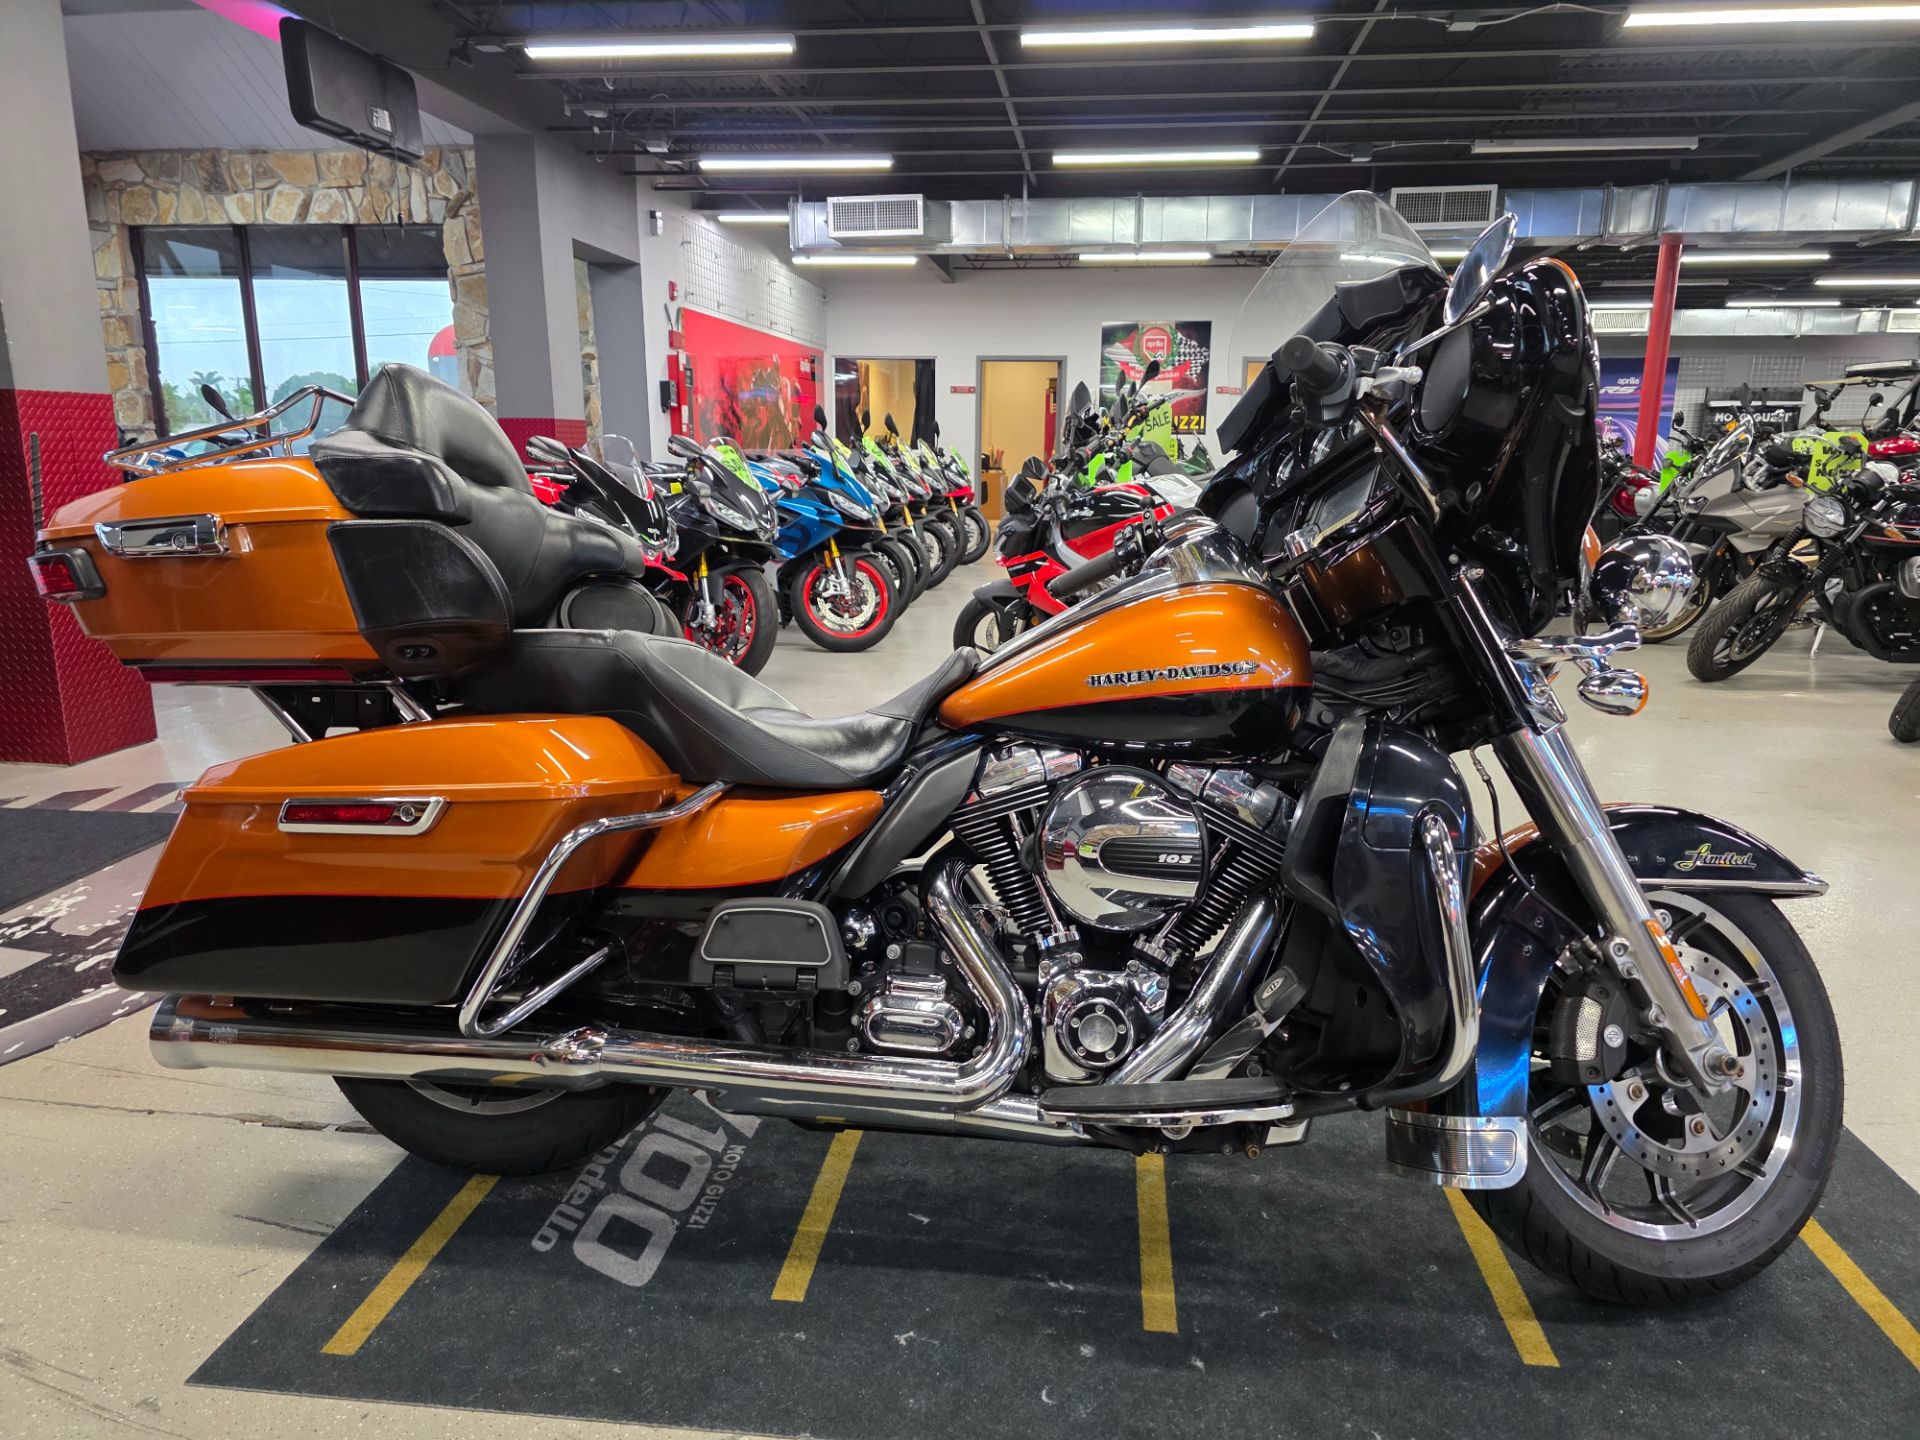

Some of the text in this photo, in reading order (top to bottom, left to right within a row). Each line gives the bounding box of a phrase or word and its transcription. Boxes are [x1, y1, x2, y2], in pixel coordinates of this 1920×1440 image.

[1617, 376, 1640, 386] aprilia
[1145, 411, 1171, 432] SALE
[1674, 843, 1758, 871] Limited
[686, 1144, 747, 1229] MOTO GUZZI
